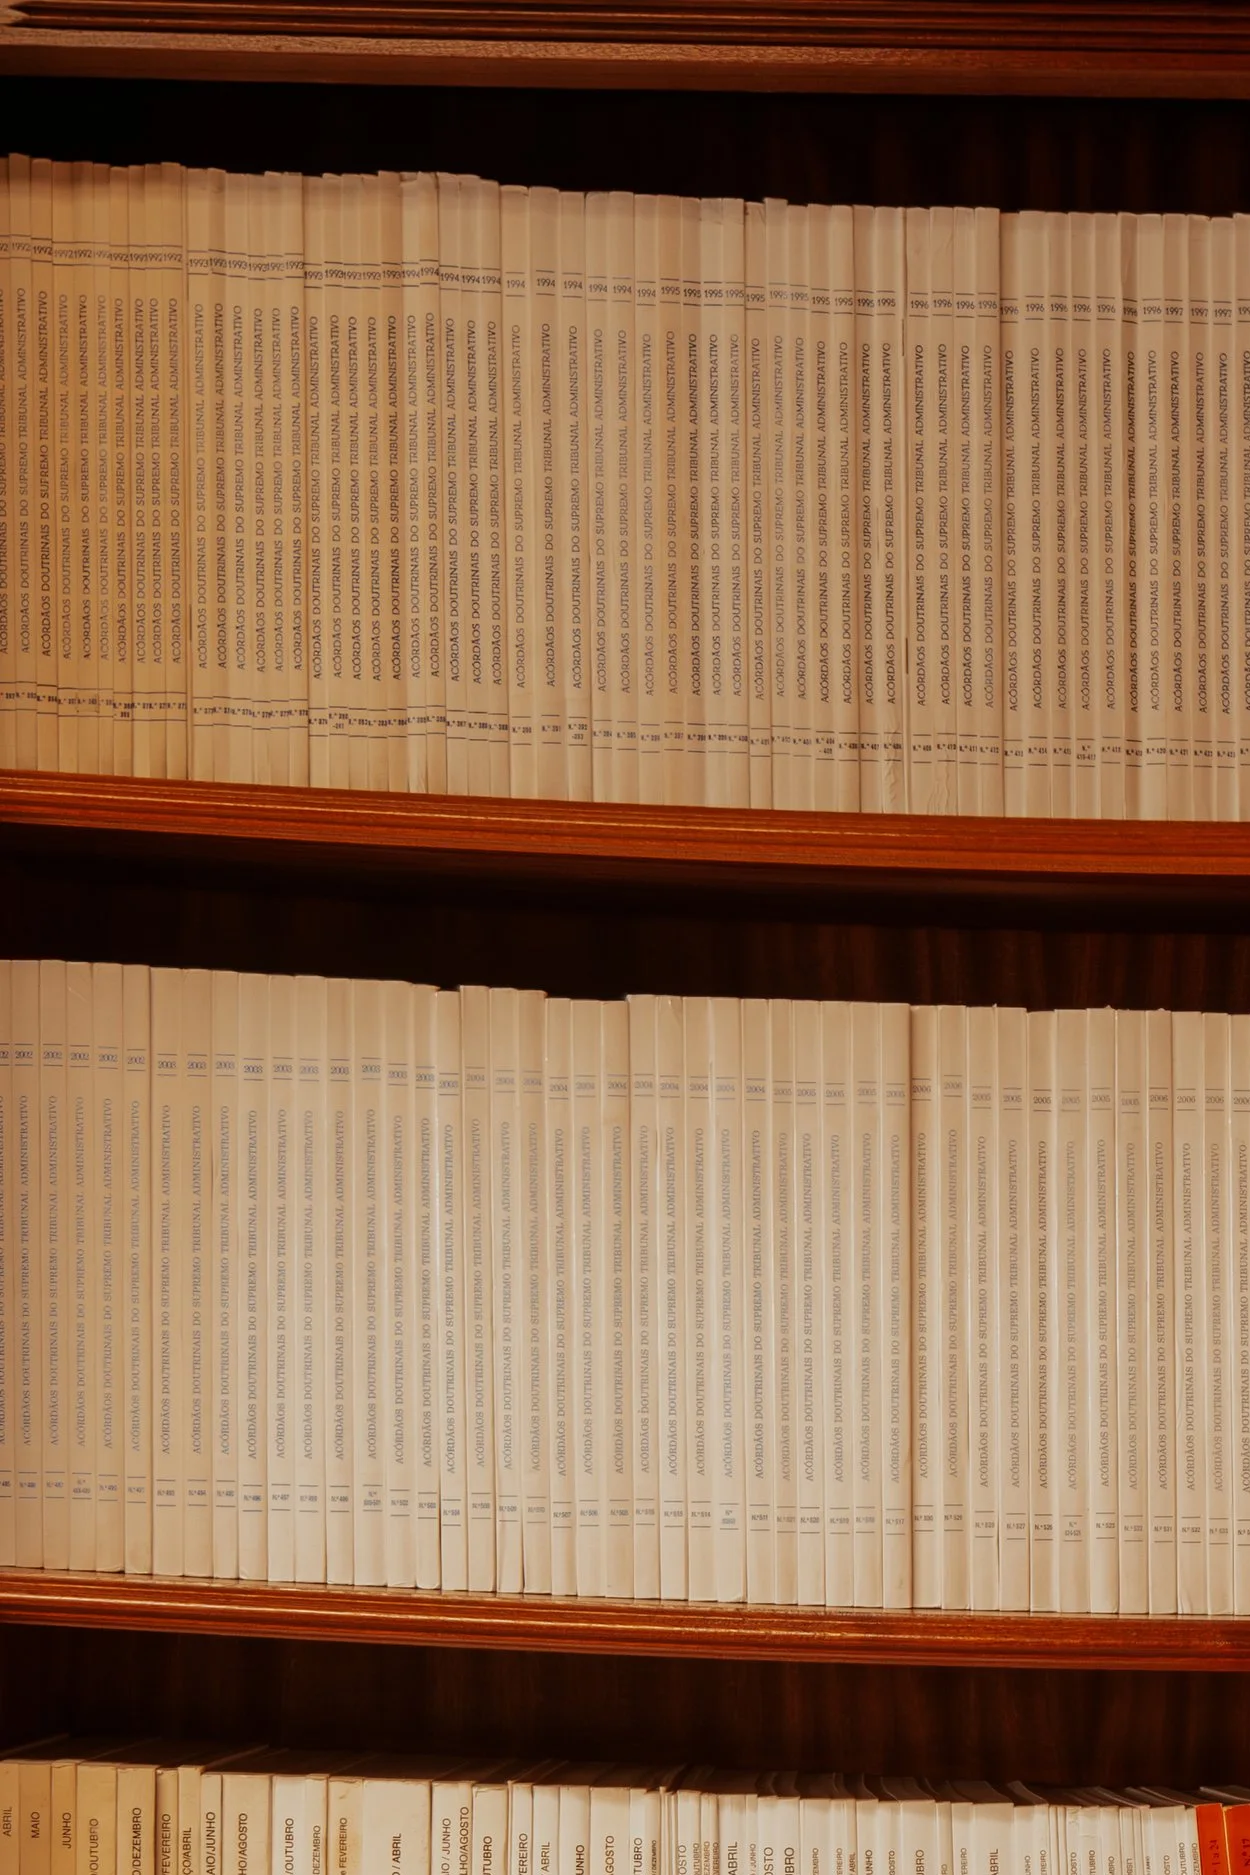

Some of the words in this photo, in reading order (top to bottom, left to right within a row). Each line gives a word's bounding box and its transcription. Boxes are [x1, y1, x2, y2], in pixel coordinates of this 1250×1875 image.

[537, 276, 556, 286] 1994
[541, 322, 551, 415] ADMINISTRATIVO
[1169, 350, 1180, 442] ADMINISTRATIVO
[542, 418, 553, 472] TRIBUNAL
[1170, 445, 1181, 499] TRIBUNAL
[543, 475, 554, 530] SUPREMO
[1171, 502, 1181, 556] SUPREMO
[544, 532, 554, 551] DO
[1171, 558, 1181, 577] DO
[544, 554, 555, 622] DOUTRINAIS
[1172, 580, 1182, 648] DOUTRINAIS
[544, 625, 556, 687] ACÓRDÃOS
[1172, 651, 1183, 712] ACÓRDÃOS
[276, 1108, 287, 1200] ADMINISTRATIVO
[276, 1203, 286, 1258] TRIBUNAL
[276, 1260, 286, 1312] SUPREMO
[276, 1314, 286, 1331] DO
[275, 1333, 286, 1399] DOUTRINAIS
[274, 1402, 286, 1459] ACÓRDÃOS
[391, 1833, 402, 1864] ABRIL
